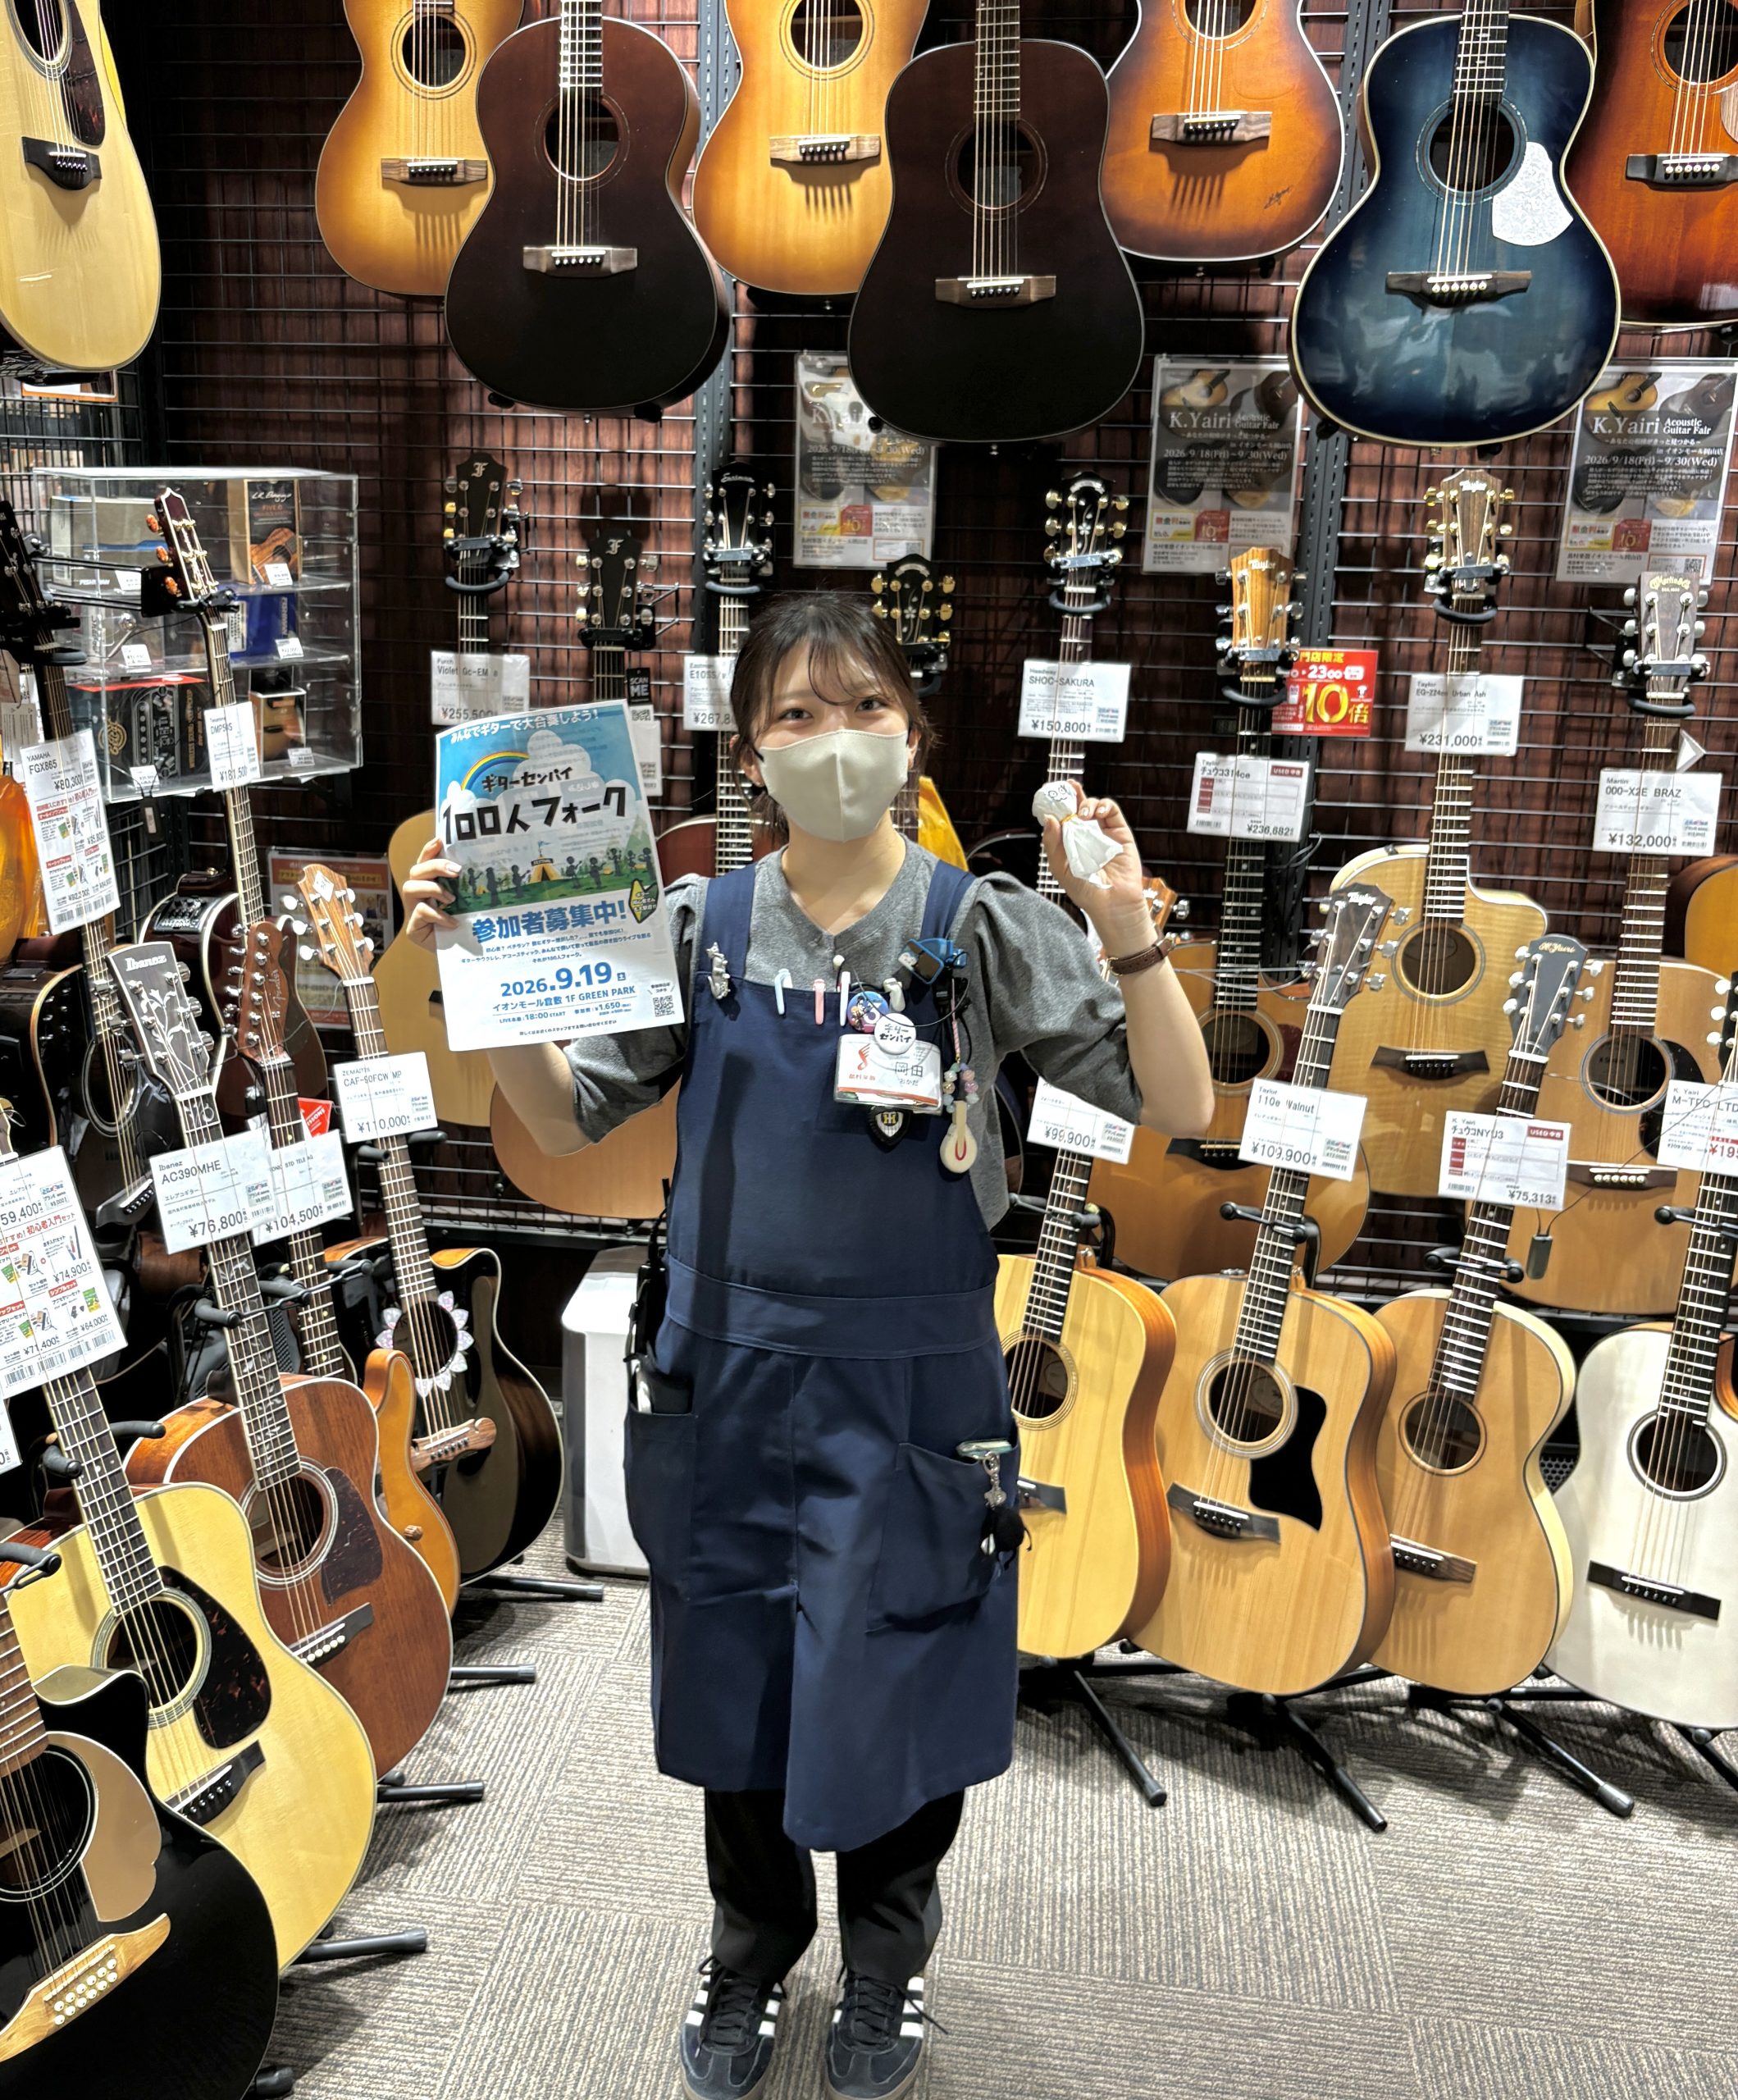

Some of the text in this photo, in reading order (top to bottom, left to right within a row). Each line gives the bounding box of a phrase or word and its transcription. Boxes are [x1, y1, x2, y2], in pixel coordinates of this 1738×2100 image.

[1169, 412, 1230, 429] K.Yairi
[1234, 421, 1280, 430] Guitar Fair
[1592, 417, 1660, 435] K.Yairi
[1664, 418, 1703, 427] Acoustic
[1663, 426, 1712, 435] Guitar Fair
[1248, 559, 1276, 572] Taylor
[1299, 651, 1344, 663] 門店限定
[437, 666, 458, 675] Violet
[630, 684, 649, 696] ME
[694, 712, 731, 724] ¥267,8
[451, 708, 598, 743] みんなでギターで大合奏しよう!
[1032, 719, 1086, 733] ¥150,800
[1419, 734, 1477, 747] ¥231,000
[27, 751, 51, 761] YAMAHA
[30, 760, 57, 774] FGX865
[481, 766, 573, 792] ギターセンパイ
[1605, 786, 1681, 798] 000-X2E BRAZ
[442, 786, 627, 844] 100人フォーク
[1608, 833, 1672, 848] ¥132,000
[472, 899, 627, 943] 参加者募集中!
[124, 954, 167, 973] Ibanez
[500, 961, 612, 997] 2026.9.19
[492, 985, 636, 1011] イオンモール倉敷 1F GREEN PARK
[525, 1011, 548, 1020] 18:00
[879, 1033, 912, 1043] センパイ
[392, 1071, 402, 1079] MP
[895, 1062, 923, 1077] 岡田
[1258, 1095, 1314, 1114] 110e Walnut
[1717, 1101, 1738, 1112] LTD
[358, 1115, 407, 1133] ¥110,000
[1045, 1125, 1090, 1148] ¥99,900
[296, 1157, 306, 1165] TELE
[1251, 1142, 1311, 1166] ¥109,900
[159, 1161, 183, 1171] Ibanez
[162, 1160, 221, 1185] AC390MHE
[165, 1189, 199, 1201] エレアコギター
[1508, 1190, 1552, 1204] ¥75,313
[0, 1203, 39, 1226] 59,400
[266, 1205, 319, 1233] ¥104,500
[189, 1211, 243, 1237] ¥76,800
[53, 1262, 88, 1284] ¥74,900
[80, 1315, 105, 1331] ¥64,000
